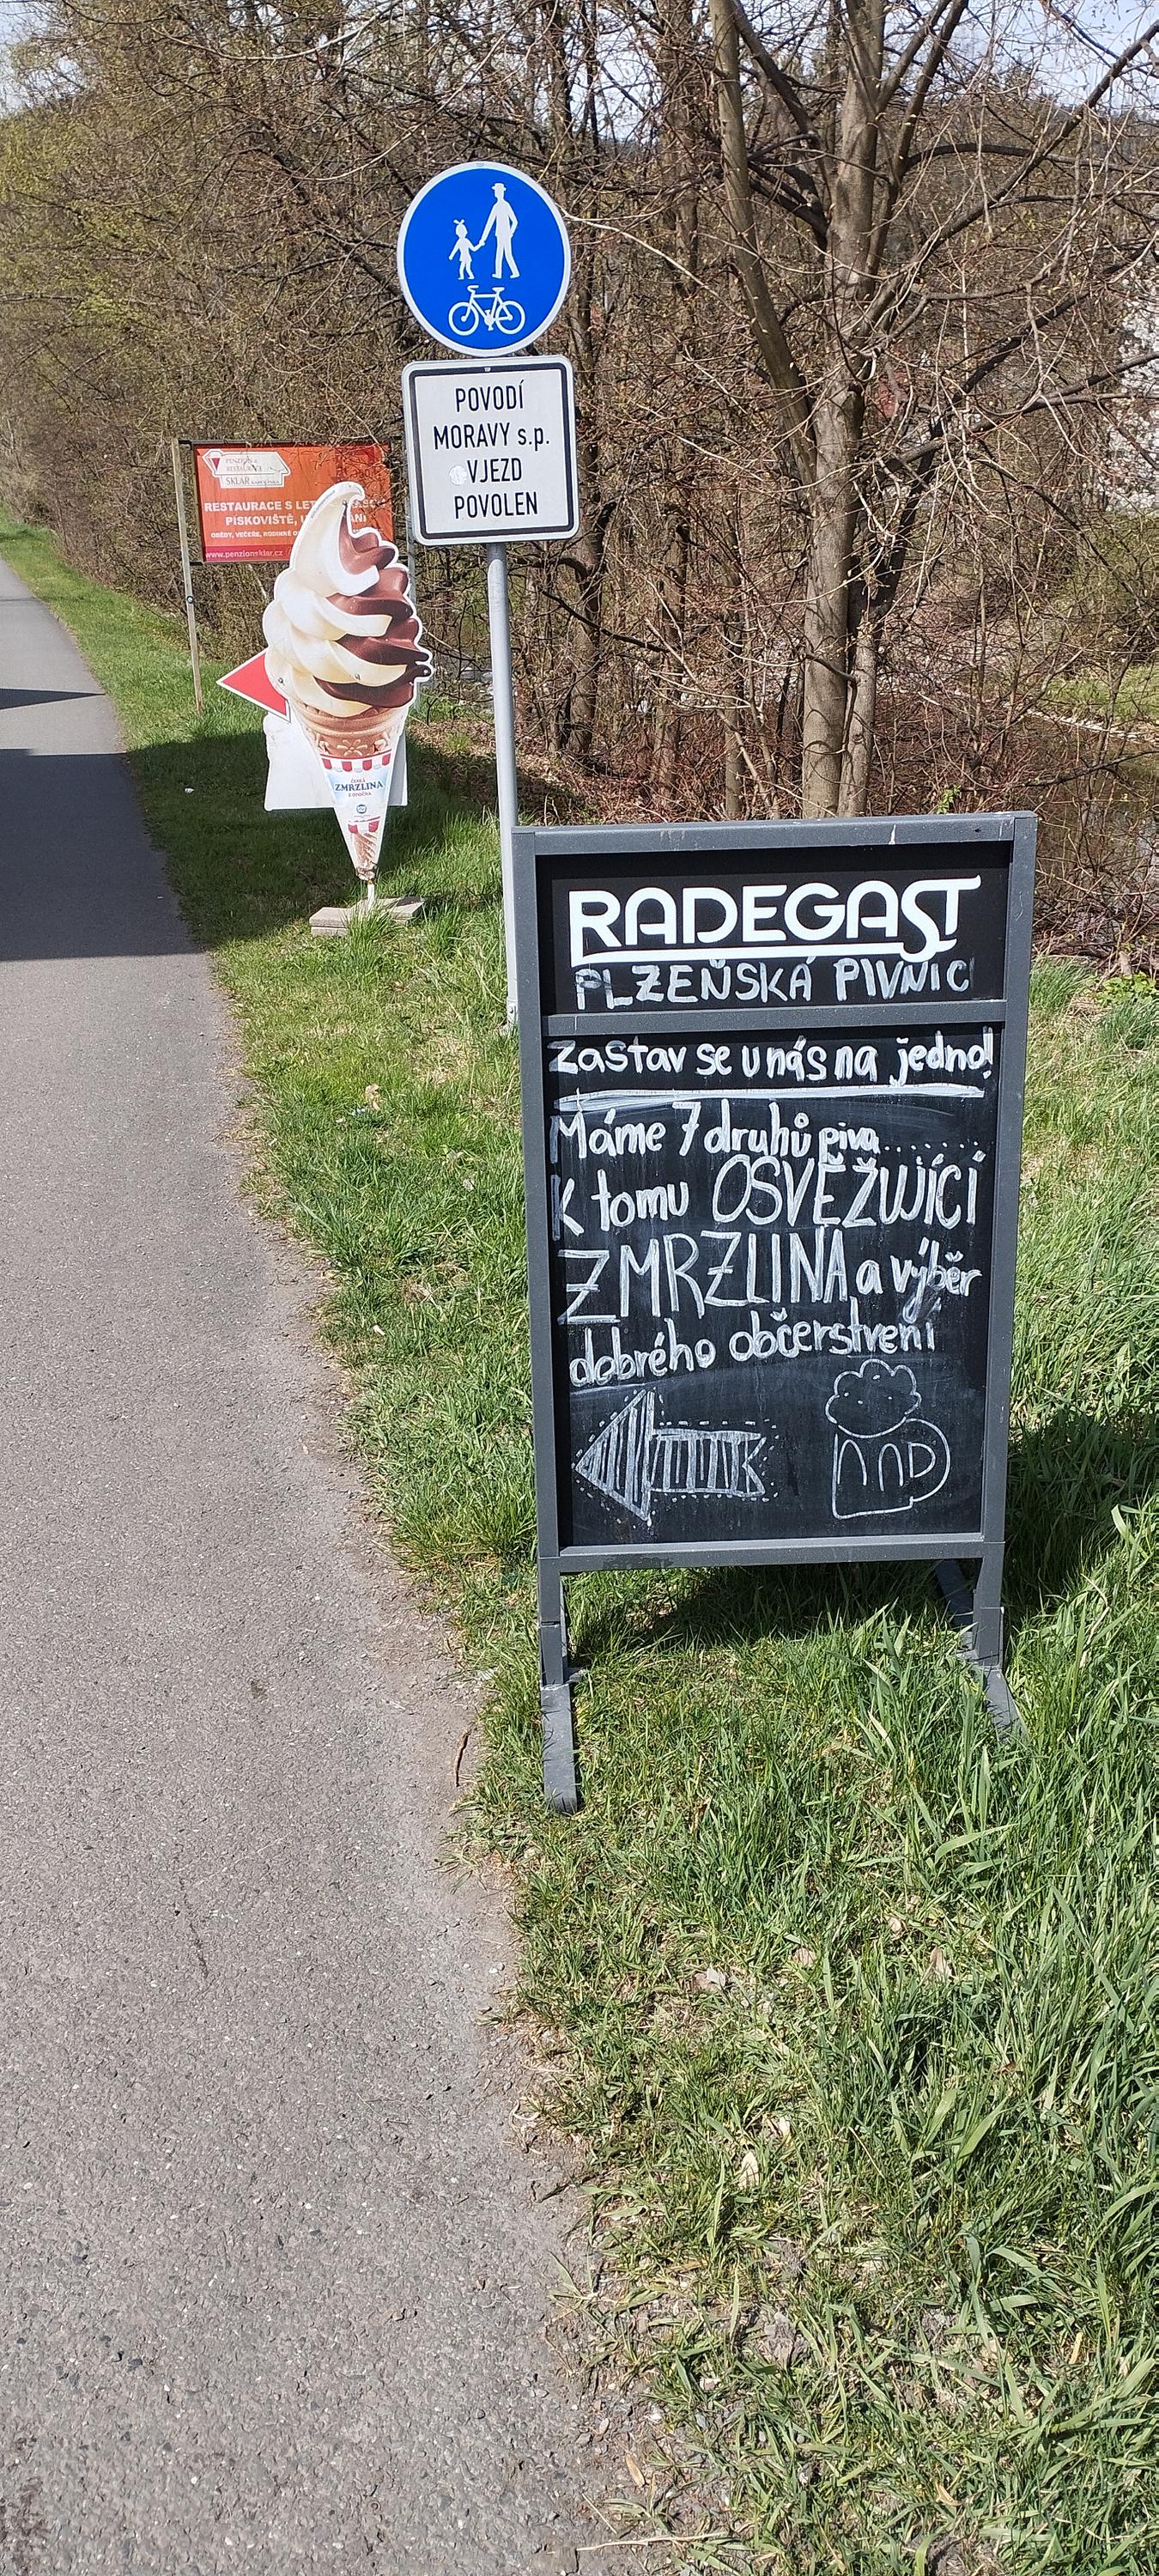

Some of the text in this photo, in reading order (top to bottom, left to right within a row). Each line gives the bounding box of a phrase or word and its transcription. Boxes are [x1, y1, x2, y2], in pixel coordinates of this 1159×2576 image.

[455, 380, 525, 412] POVODÍ
[434, 422, 549, 452] MORAVY s.p.
[466, 458, 522, 483] VJEZD
[204, 501, 282, 512] RESTAURACE
[285, 501, 293, 509] S
[454, 491, 538, 519] POVOLEN
[206, 550, 283, 559] www.penzionsklar.cz
[335, 781, 384, 792] ZMRZLINA
[568, 874, 982, 967] RADEGAST
[574, 955, 815, 1011] PLZEŇSKÁ
[696, 1042, 732, 1076] se
[834, 1045, 877, 1084] na
[889, 1025, 993, 1086] jedno!
[549, 1108, 666, 1164] Máme
[672, 1101, 701, 1157] 7
[704, 1098, 811, 1157] druhů
[550, 1150, 986, 1242] K tomu OSVĚŽUJÍCÍ
[558, 1225, 983, 1325] ZMRZLINA a výběr
[569, 1317, 717, 1388] dobrého
